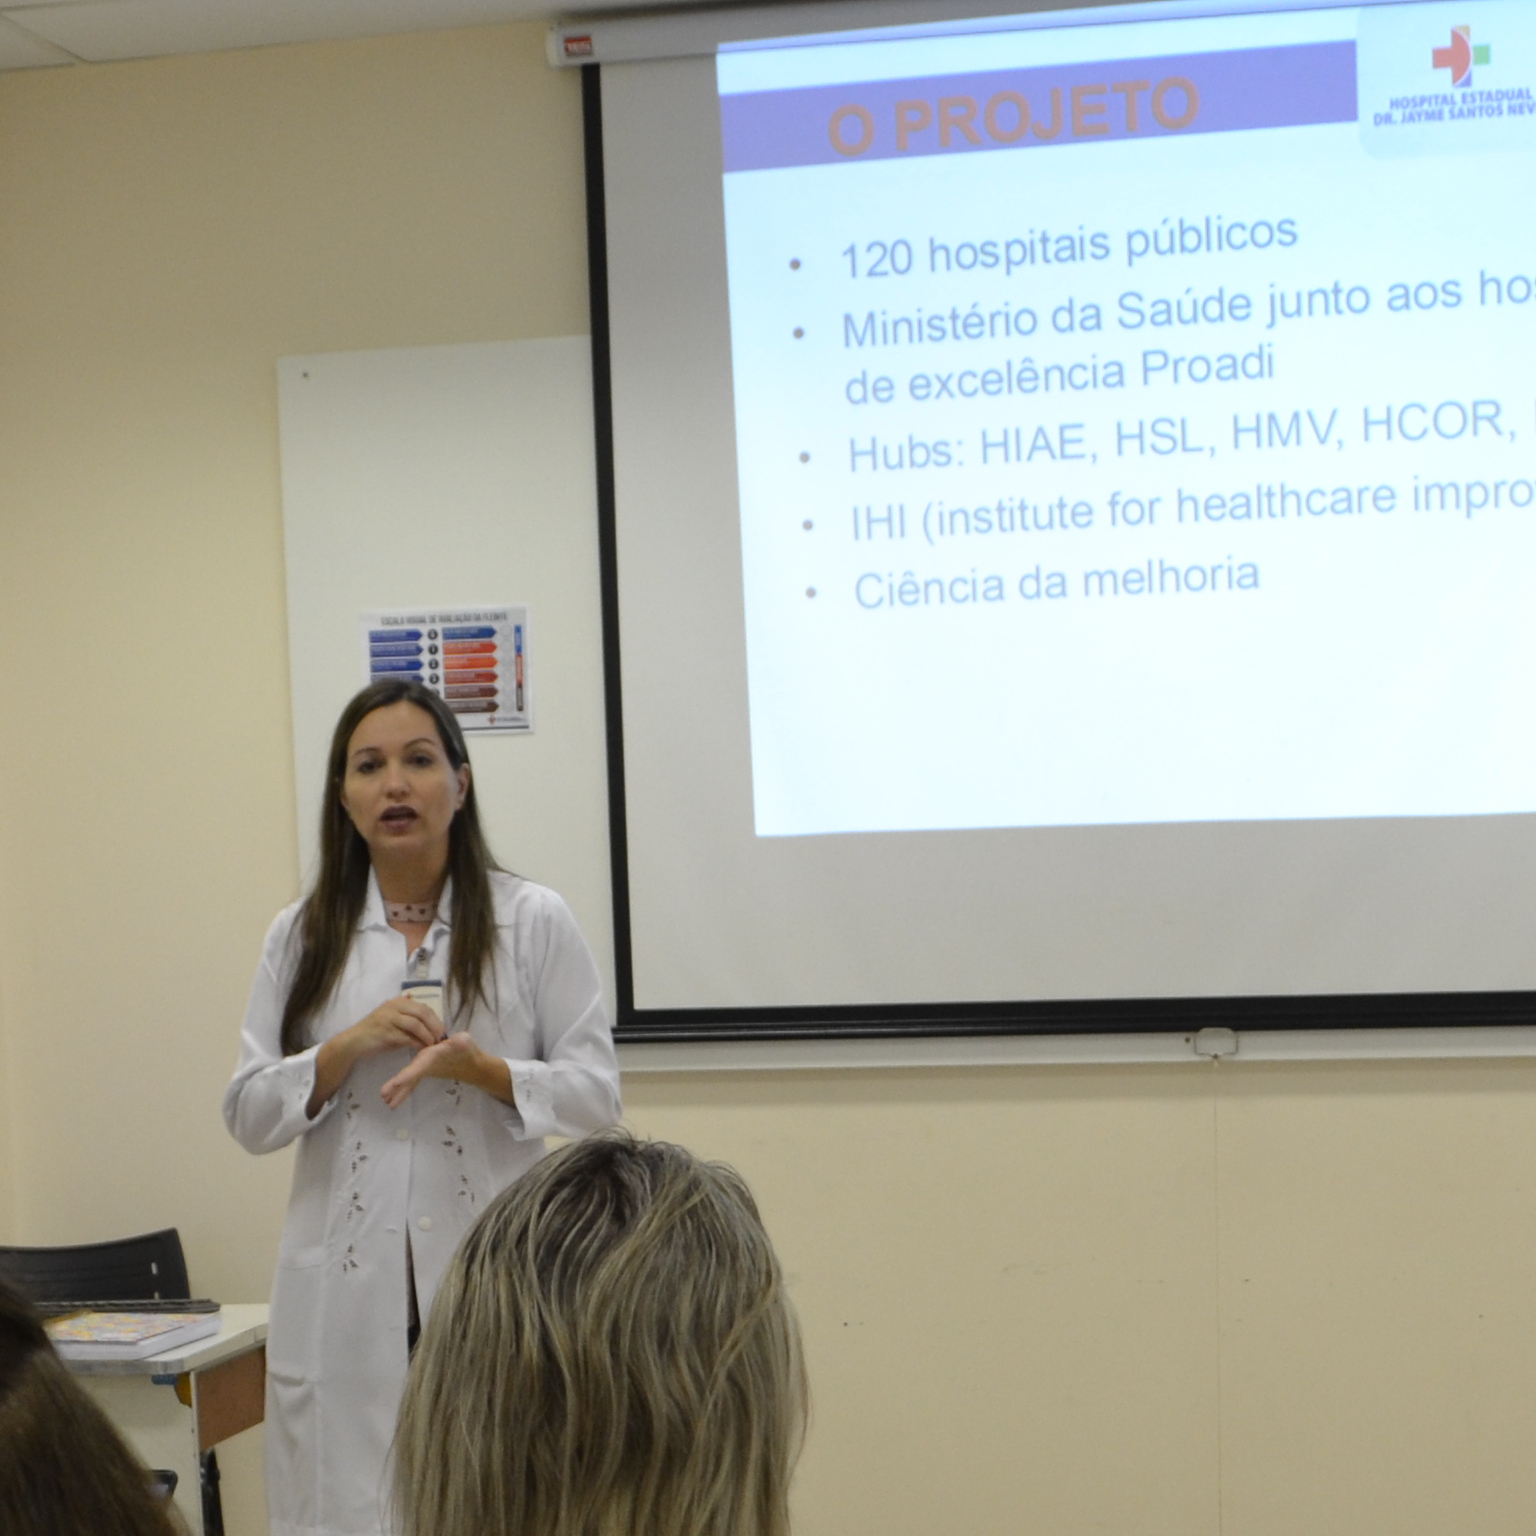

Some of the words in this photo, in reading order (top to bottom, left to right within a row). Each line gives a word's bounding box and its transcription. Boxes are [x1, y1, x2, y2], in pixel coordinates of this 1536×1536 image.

[828, 103, 875, 157] O
[895, 75, 1200, 151] PROJETO
[1389, 93, 1457, 110] HOSPITAL
[1461, 87, 1534, 105] ESTADUAL
[1400, 107, 1445, 124] JAYME
[1448, 104, 1503, 121] SANTOS
[842, 238, 913, 279] 120
[929, 224, 1111, 276] hospitais
[1126, 214, 1298, 268] públicos
[843, 302, 1038, 349] Ministério
[1051, 297, 1103, 334] da
[1117, 285, 1253, 330] Saúde
[1266, 282, 1371, 330] junto
[1386, 279, 1463, 312] aos
[845, 369, 895, 405] de
[908, 354, 1125, 401] excelência
[1142, 342, 1275, 387] Proadi
[849, 433, 965, 473] Hubs:
[981, 422, 1098, 466] HIAE,
[1116, 415, 1217, 459] HSL,
[1232, 408, 1345, 452] HMV,
[1363, 400, 1517, 443] HCOR,
[852, 503, 907, 541] IHI
[921, 495, 1095, 546] (institute
[1108, 490, 1163, 528] for
[1177, 481, 1397, 523] healthcare
[855, 568, 1005, 610] Ciência
[1018, 565, 1069, 601] da
[1083, 555, 1261, 598] melhoria
